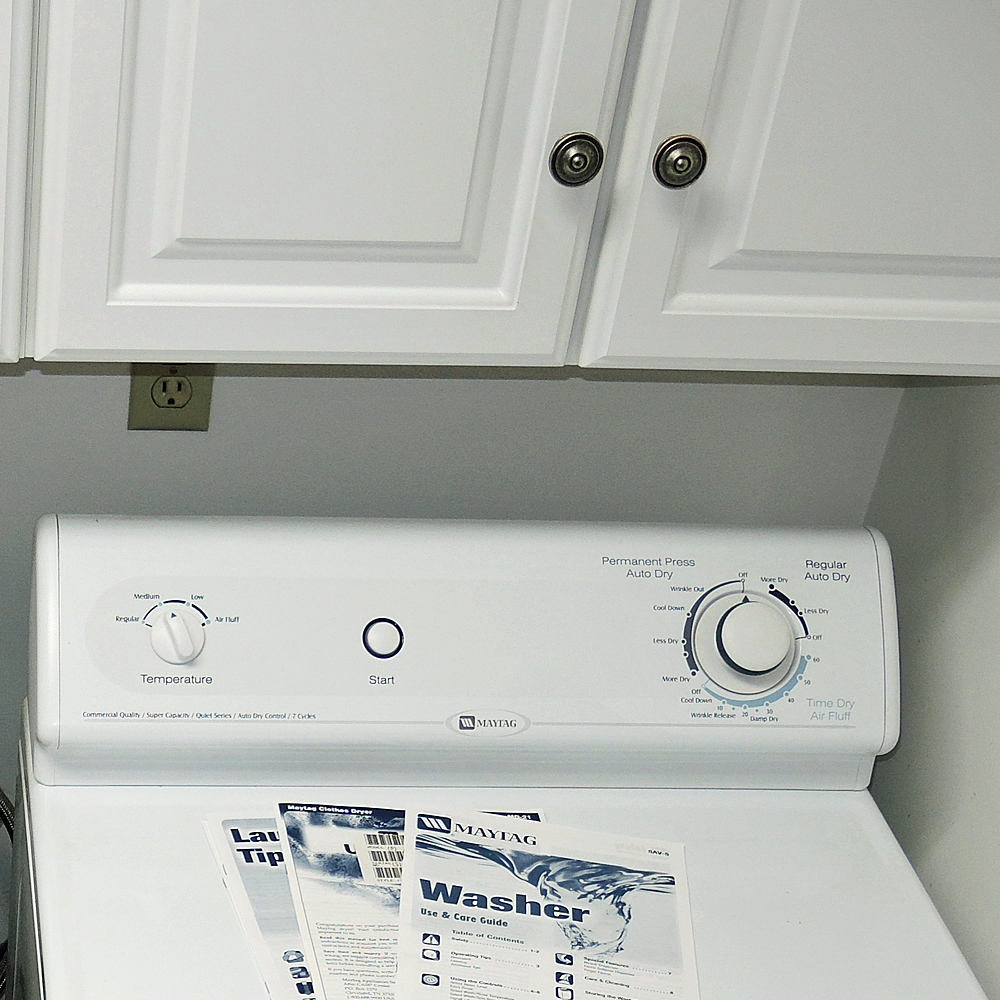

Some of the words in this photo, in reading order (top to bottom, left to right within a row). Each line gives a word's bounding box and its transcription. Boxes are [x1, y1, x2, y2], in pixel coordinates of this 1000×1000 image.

[602, 556, 663, 567] Permanent
[664, 557, 696, 567] Press
[805, 559, 847, 570] Regular
[626, 569, 652, 578] Auto
[655, 569, 674, 581] Dry
[804, 571, 830, 581] Auto
[832, 572, 850, 583] Dry
[668, 638, 678, 646] Dry
[140, 673, 213, 686] Temperature
[369, 675, 395, 685] Start
[806, 698, 835, 708] Time
[838, 699, 856, 710] Dry
[119, 711, 140, 719] Quality
[146, 712, 164, 720] Super
[164, 712, 190, 720] Capacity
[252, 713, 263, 721] Dry
[297, 713, 316, 721] Cycles
[810, 712, 826, 721] Air
[828, 712, 851, 721] Fluff
[476, 719, 517, 728] MAYTAG
[287, 804, 317, 812] Maytag
[453, 823, 538, 846] MAYTAG
[418, 878, 591, 923] Washer
[420, 908, 440, 918] Use
[441, 911, 451, 919] &
[453, 913, 477, 924] Care
[479, 916, 509, 928] Guide
[452, 929, 473, 937] Table
[487, 934, 525, 944] Contents
